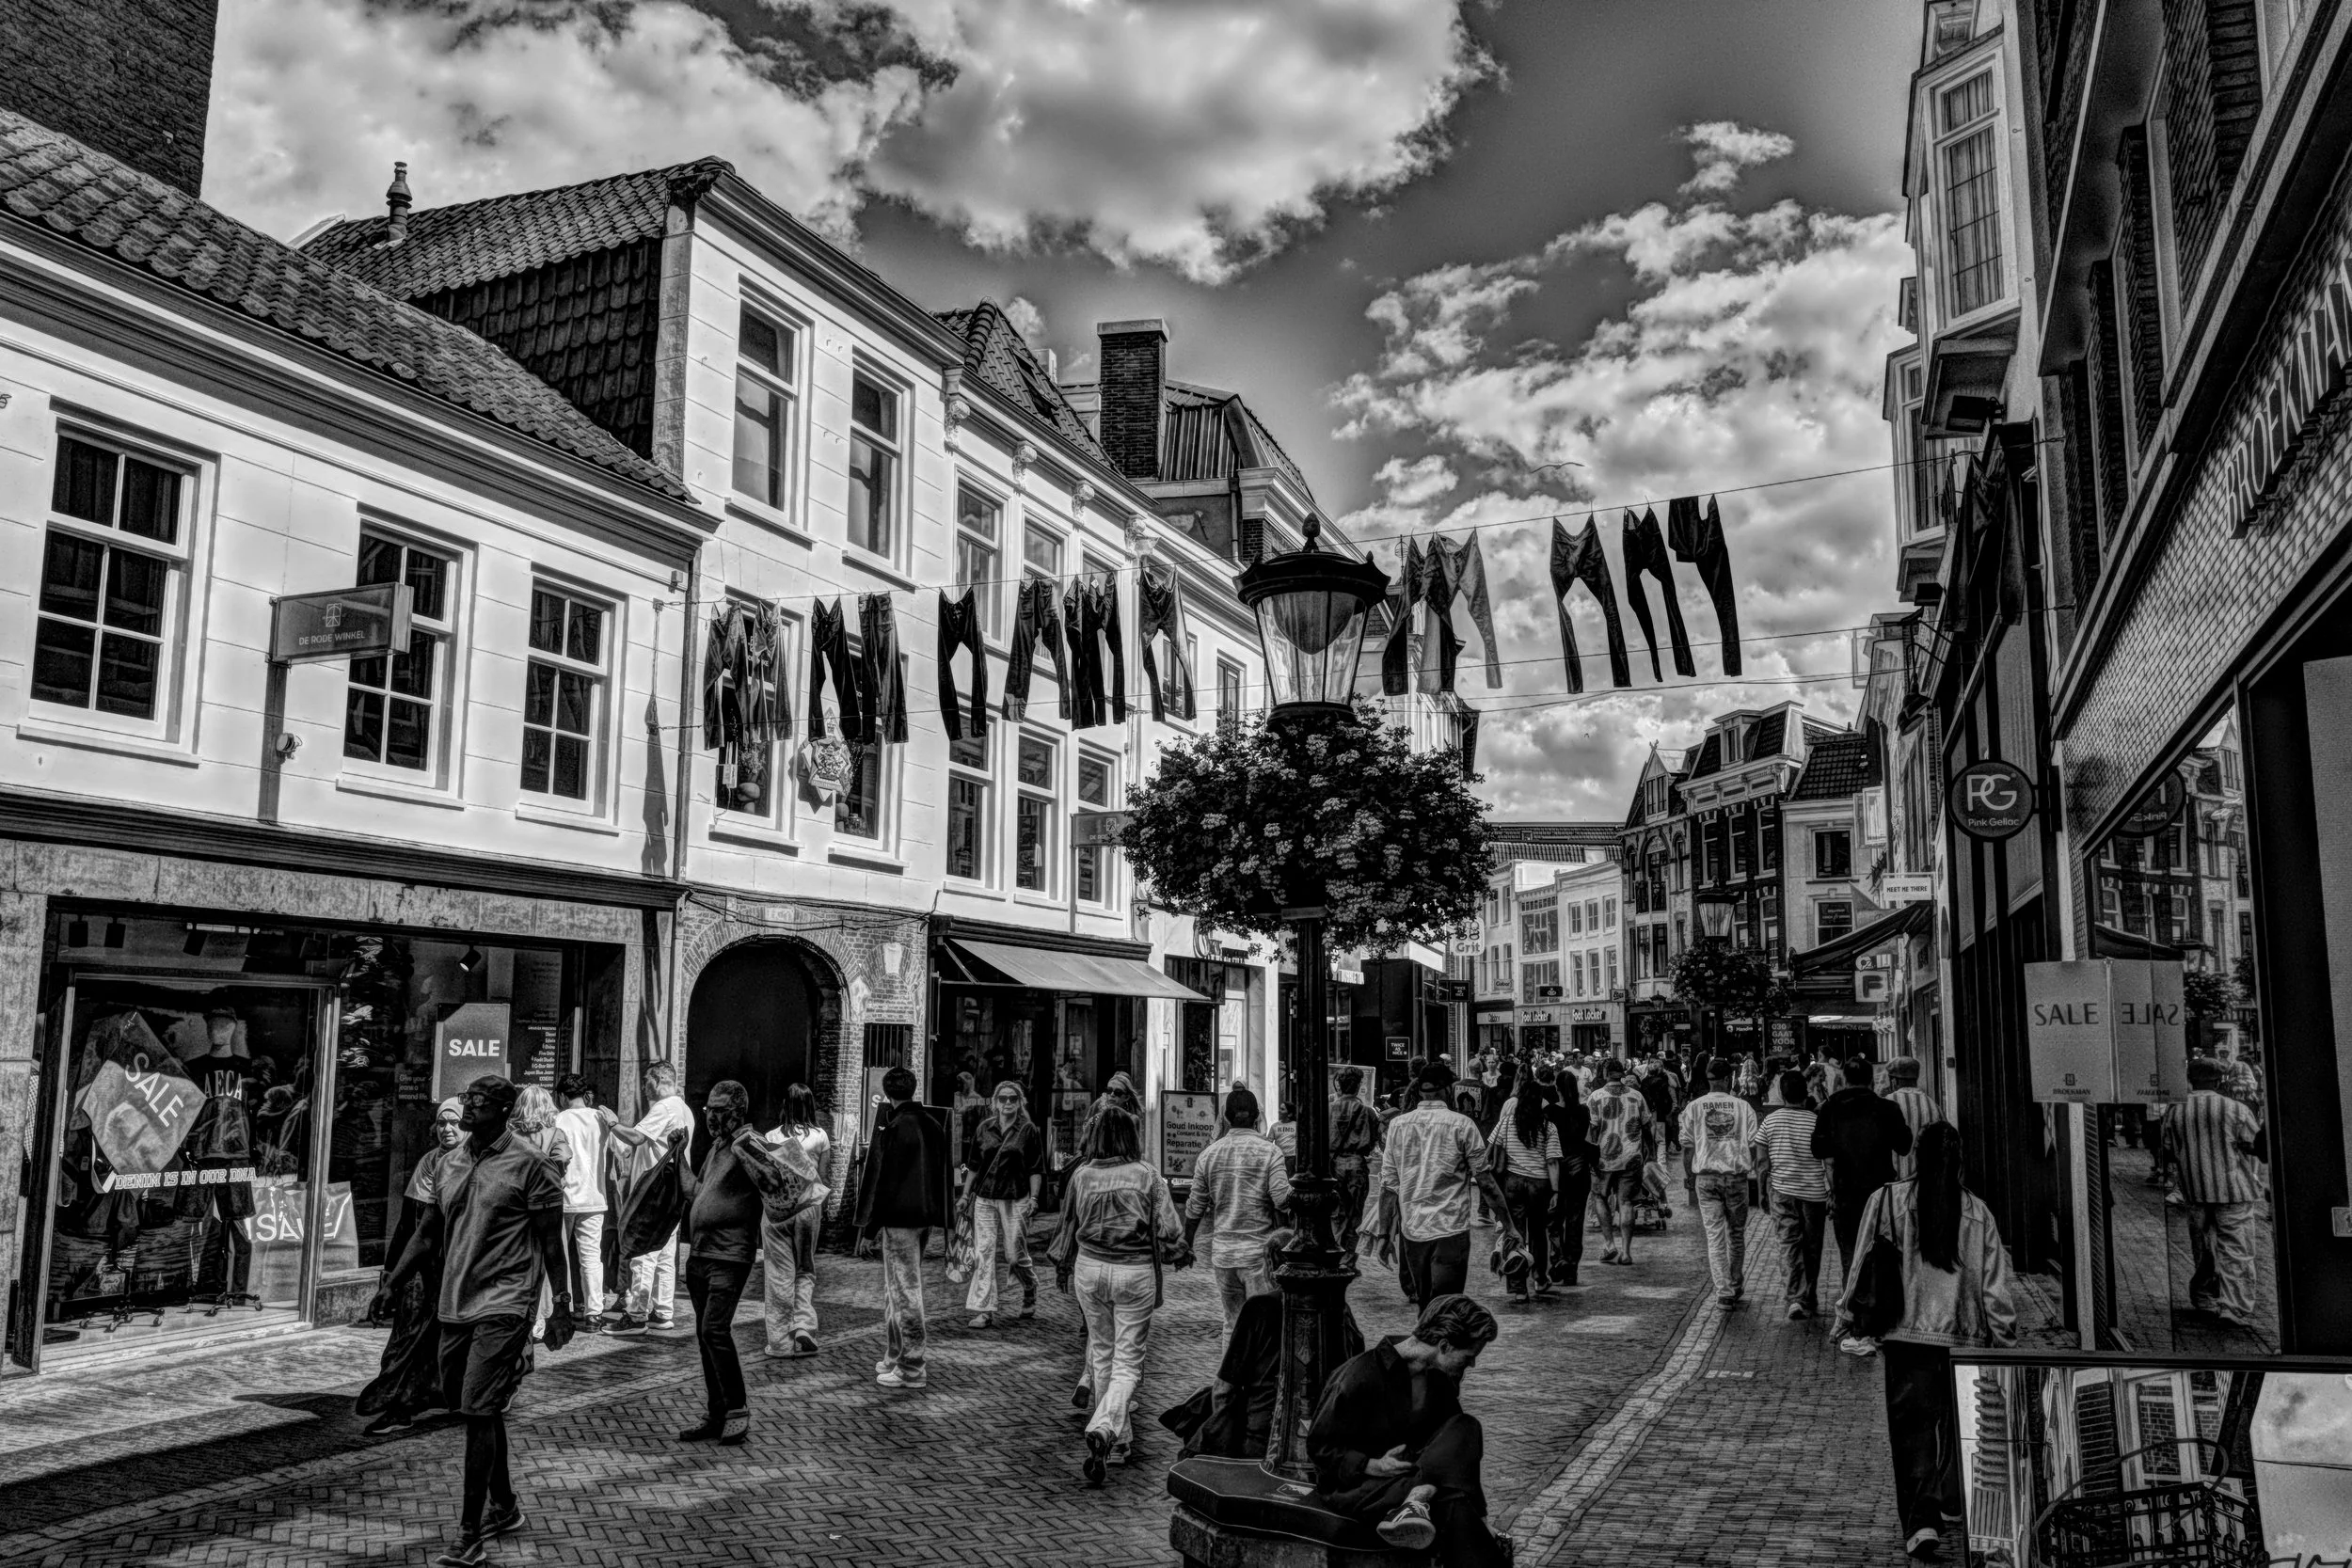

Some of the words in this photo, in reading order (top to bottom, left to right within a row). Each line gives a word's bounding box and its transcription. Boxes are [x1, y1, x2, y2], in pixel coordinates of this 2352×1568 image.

[298, 636, 310, 645] DE
[310, 634, 332, 644] RODE
[334, 630, 365, 641] WINKEL
[1966, 773, 2017, 812] PG
[1967, 817, 1987, 827] Pink
[1989, 817, 2020, 827] Gellac
[1456, 942, 1480, 953] Grit
[1521, 1010, 1532, 1022] Foot
[1533, 1010, 1551, 1022] Locker
[1572, 1008, 1584, 1022] Foot
[1584, 1008, 1606, 1022] Locker
[2033, 1003, 2099, 1026] SALE
[448, 1038, 501, 1056] SALE
[399, 1073, 412, 1082] Give
[124, 1052, 184, 1128] SALE
[399, 1084, 414, 1092] jeans
[1703, 1101, 1734, 1110] RAMEN
[1167, 1120, 1186, 1130] Goud
[1187, 1122, 1215, 1132] Inkoop
[1167, 1138, 1202, 1148] Reparatie
[115, 1173, 162, 1190] DENIM
[164, 1172, 179, 1187] IS
[181, 1170, 196, 1186] IN
[199, 1169, 228, 1185] OUR
[229, 1166, 258, 1182] DNA
[256, 1213, 334, 1242] SA
